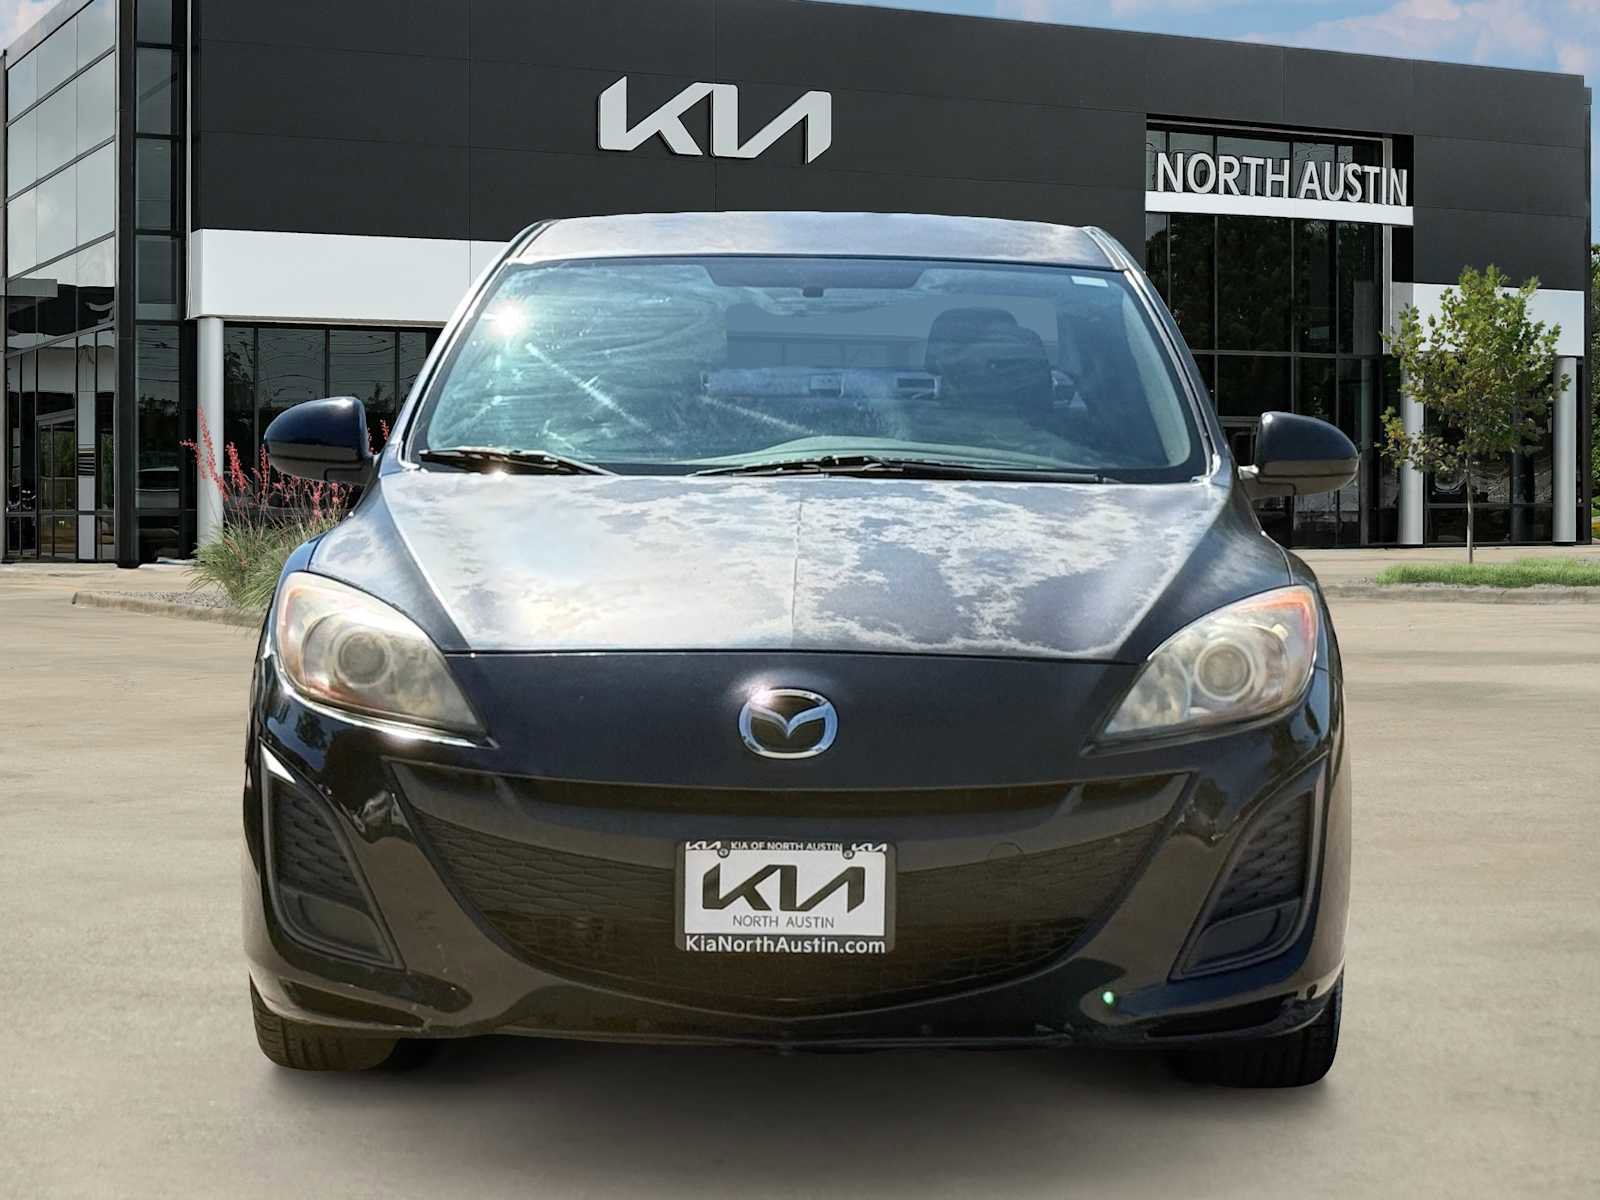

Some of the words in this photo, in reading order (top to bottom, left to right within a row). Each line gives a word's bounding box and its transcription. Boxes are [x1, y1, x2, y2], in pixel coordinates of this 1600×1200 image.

[1156, 151, 1290, 198] NORTH
[1300, 160, 1408, 206] AUSTIN
[730, 841, 749, 850] KIA
[751, 841, 764, 850] OF
[767, 842, 801, 850] NORTH
[806, 843, 842, 851] AUSTIN
[732, 915, 779, 928] NORTH
[786, 916, 835, 929] AUSTIN
[685, 935, 886, 955] KiaNorthAustin.com
